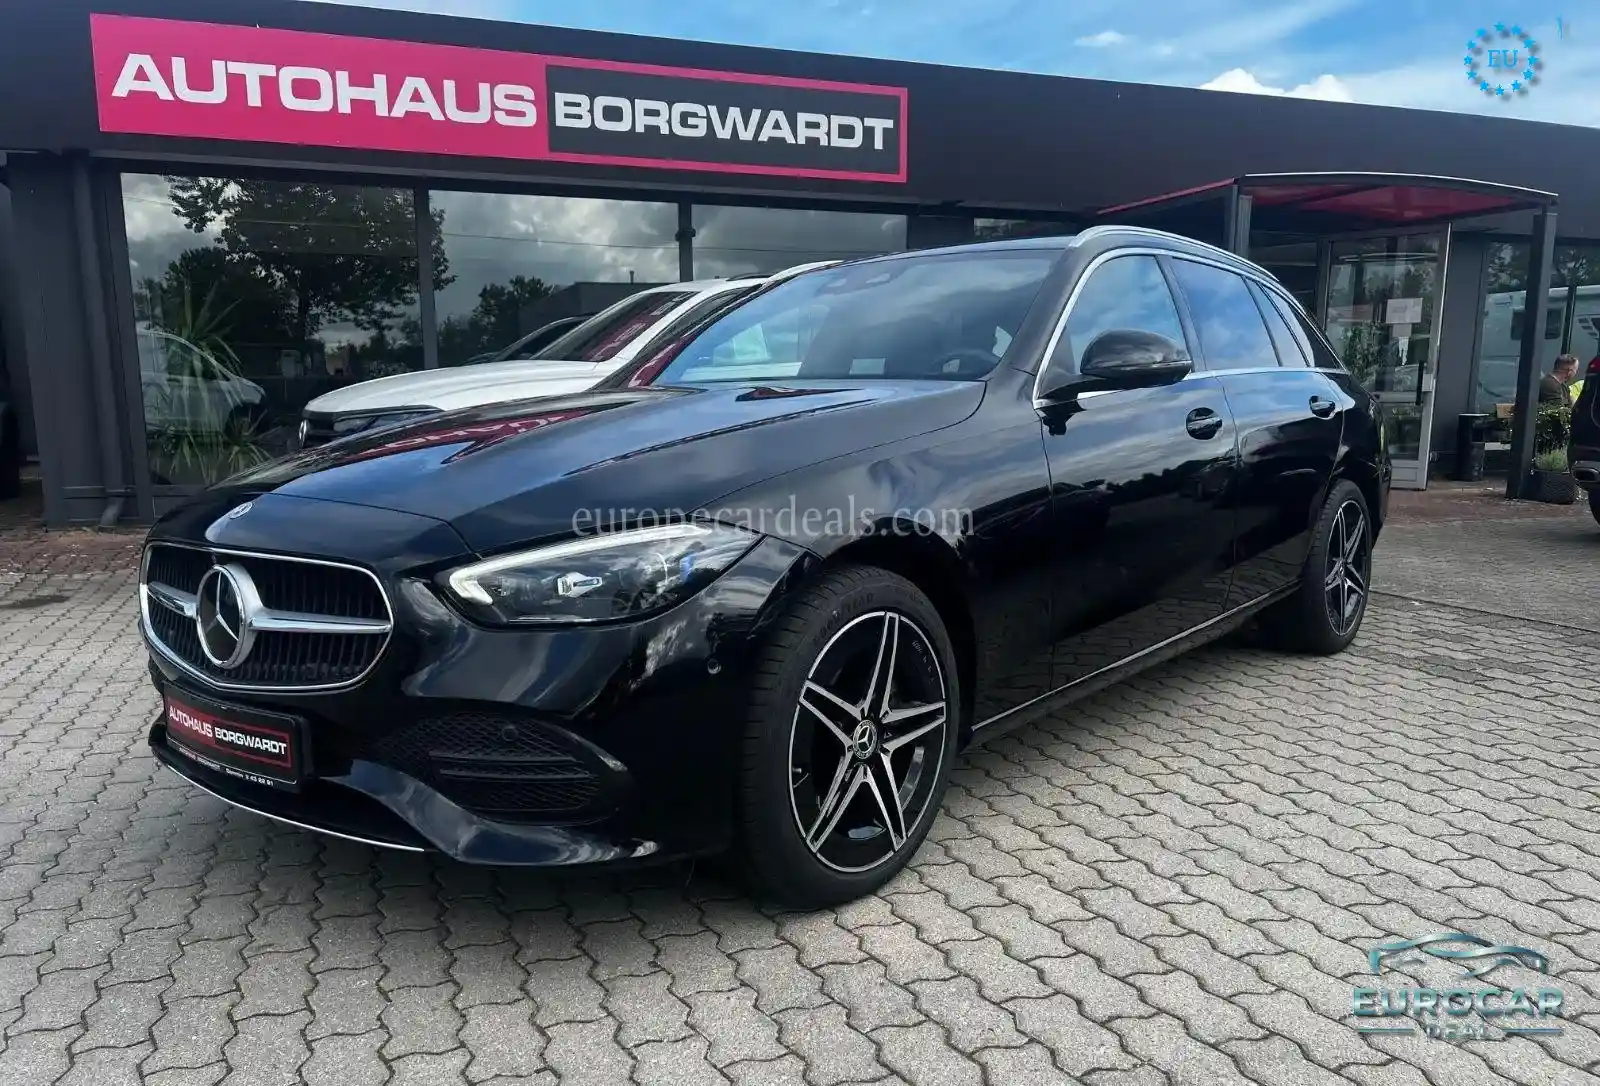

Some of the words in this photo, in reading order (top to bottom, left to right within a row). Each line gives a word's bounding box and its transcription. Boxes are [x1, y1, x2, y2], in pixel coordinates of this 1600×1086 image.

[112, 53, 537, 127] AUTOHAUS
[555, 92, 893, 150] BORGWARDT
[169, 705, 213, 738] AUTOHAUS
[214, 727, 287, 755] BORGWARDT
